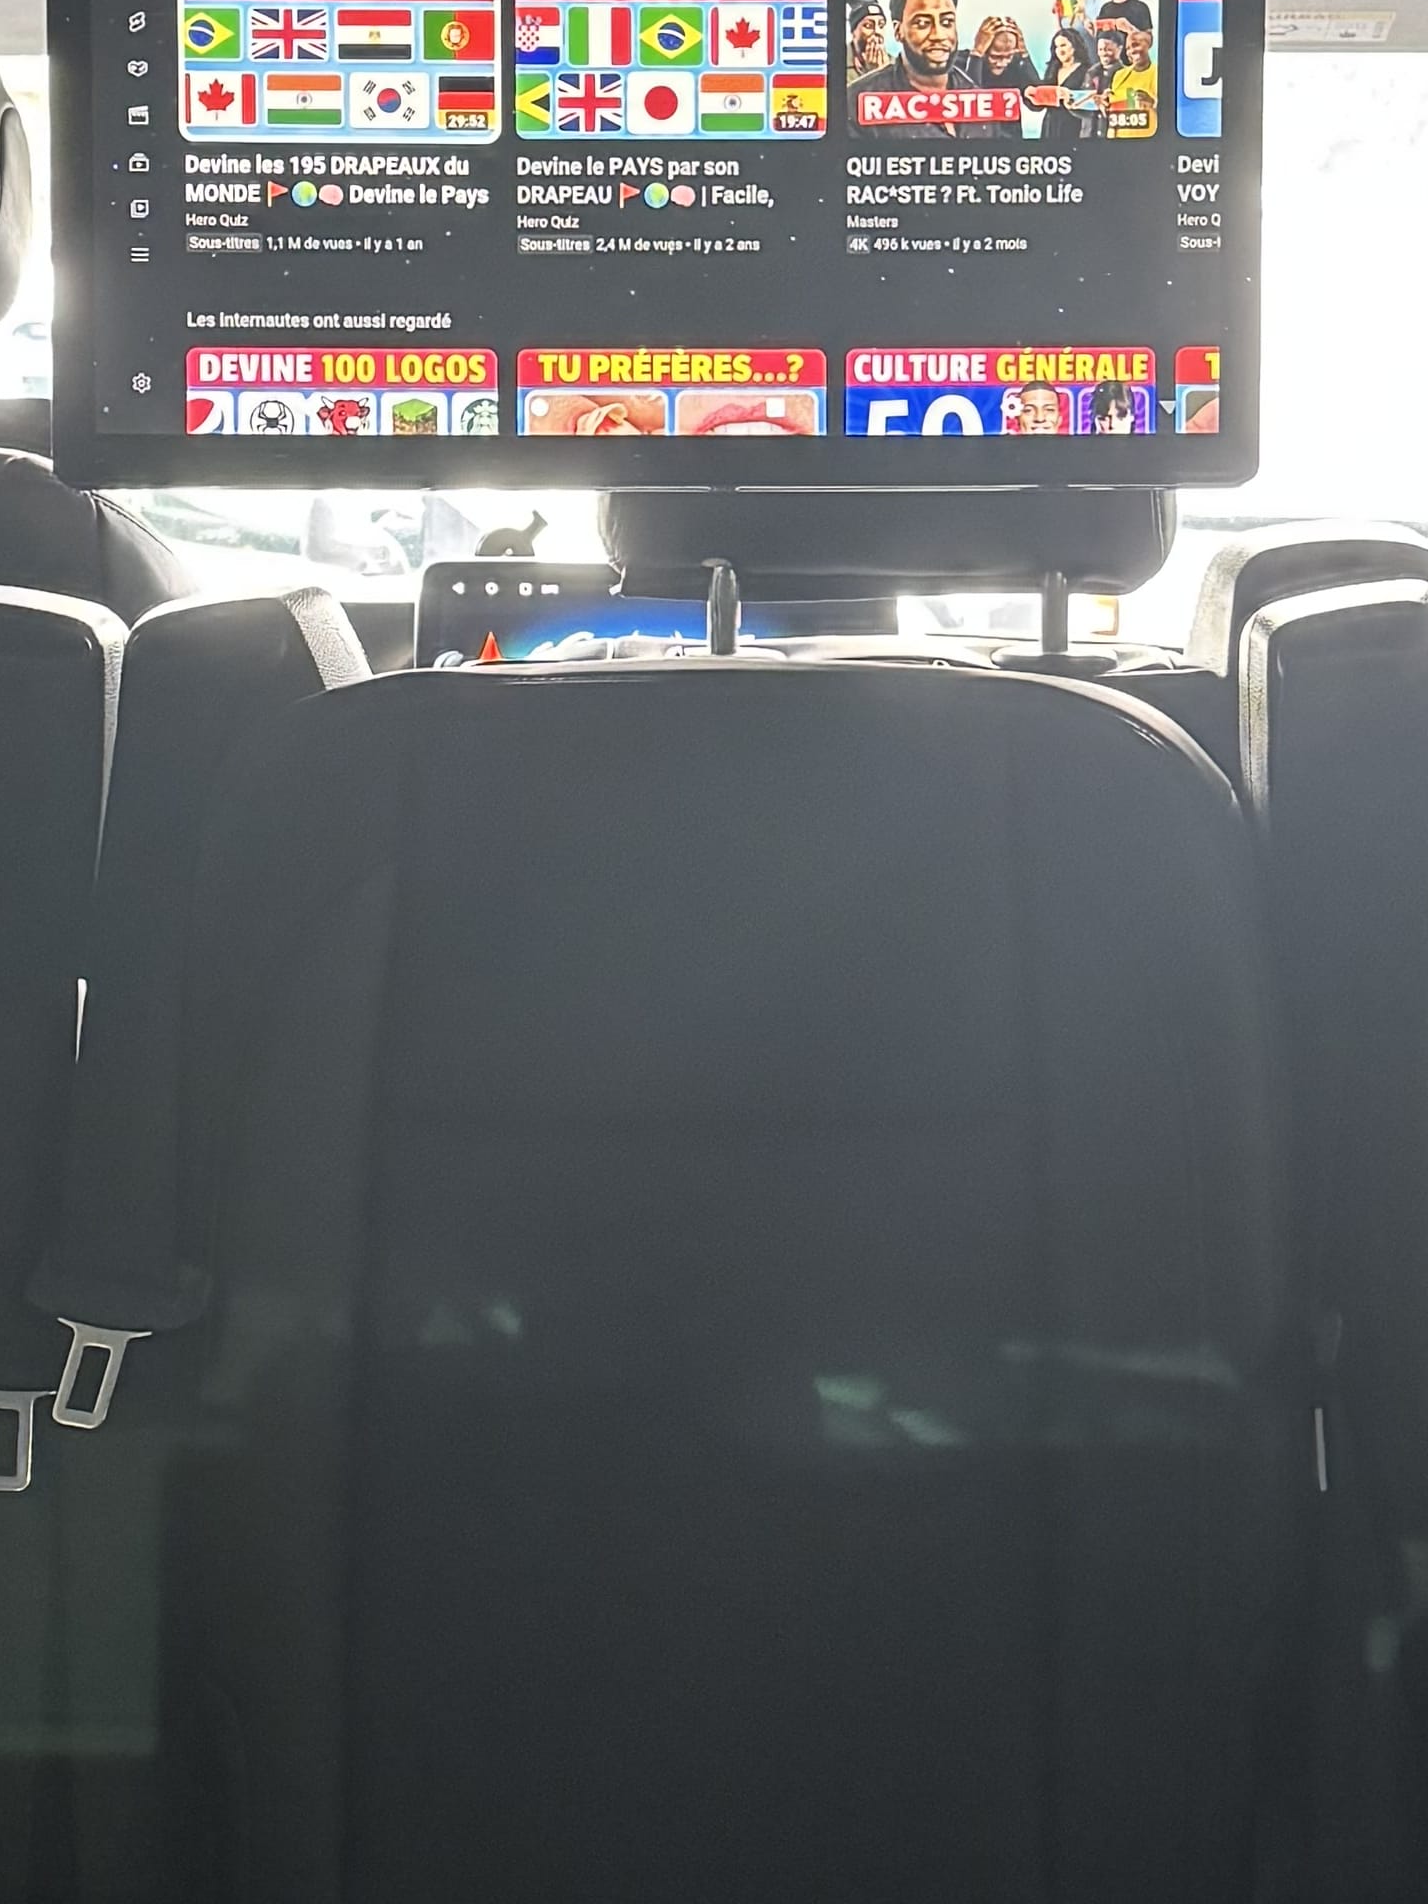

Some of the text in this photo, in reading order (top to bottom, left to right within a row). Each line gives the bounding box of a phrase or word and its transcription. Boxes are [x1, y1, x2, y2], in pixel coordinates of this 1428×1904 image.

[1003, 92, 1018, 118] ?
[447, 115, 486, 129] 29:52
[778, 115, 816, 129] 19:47
[1109, 113, 1147, 128] 38:05
[185, 153, 470, 176] Devine les 195 DRAPEAUX du
[516, 155, 740, 181] Devine le PAYS par son
[846, 155, 1072, 178] QUI EST LE PLUS GROS
[1177, 153, 1220, 174] Devi
[185, 183, 490, 210] MONDE Devine le Pays
[517, 185, 613, 205] DRAPEAU
[711, 184, 774, 209] Facile,
[940, 185, 953, 204] ?
[956, 184, 982, 204] Ft.
[985, 183, 1042, 204] Tonio
[1046, 183, 1084, 203] Life
[1176, 183, 1220, 203] VOY
[185, 213, 249, 228] Hero Quiz
[516, 215, 580, 230] Hero Quiz
[846, 214, 899, 228] Masters
[1177, 213, 1209, 227] Hero
[189, 236, 259, 250] Sous-titres
[266, 236, 284, 251] 1,1
[287, 236, 301, 250] M
[303, 236, 321, 250] de
[322, 239, 353, 250] vues
[373, 239, 382, 254] y
[384, 239, 393, 251] a
[395, 237, 403, 251] 1
[406, 239, 423, 251] an
[520, 238, 590, 251] Sous-titres
[595, 237, 616, 253] 2,4
[618, 237, 632, 251] M
[633, 237, 651, 251] de
[703, 240, 712, 255] y
[714, 240, 723, 251] a
[725, 237, 735, 252] 2
[736, 240, 761, 251] ans
[850, 238, 868, 251] 4K
[873, 237, 899, 251] 496
[900, 237, 910, 251] k
[911, 239, 942, 251] vues
[962, 239, 971, 254] y
[973, 239, 982, 250] a
[983, 236, 993, 251] 2
[995, 237, 1028, 250] mois
[186, 311, 452, 333] Les internautes ont aussi regardé
[199, 353, 487, 384] DEVINE 100 LOGOS
[537, 346, 804, 384] TU PRÉFÈRES...?
[853, 347, 1149, 383] CULTURE GÉNÉRALE
